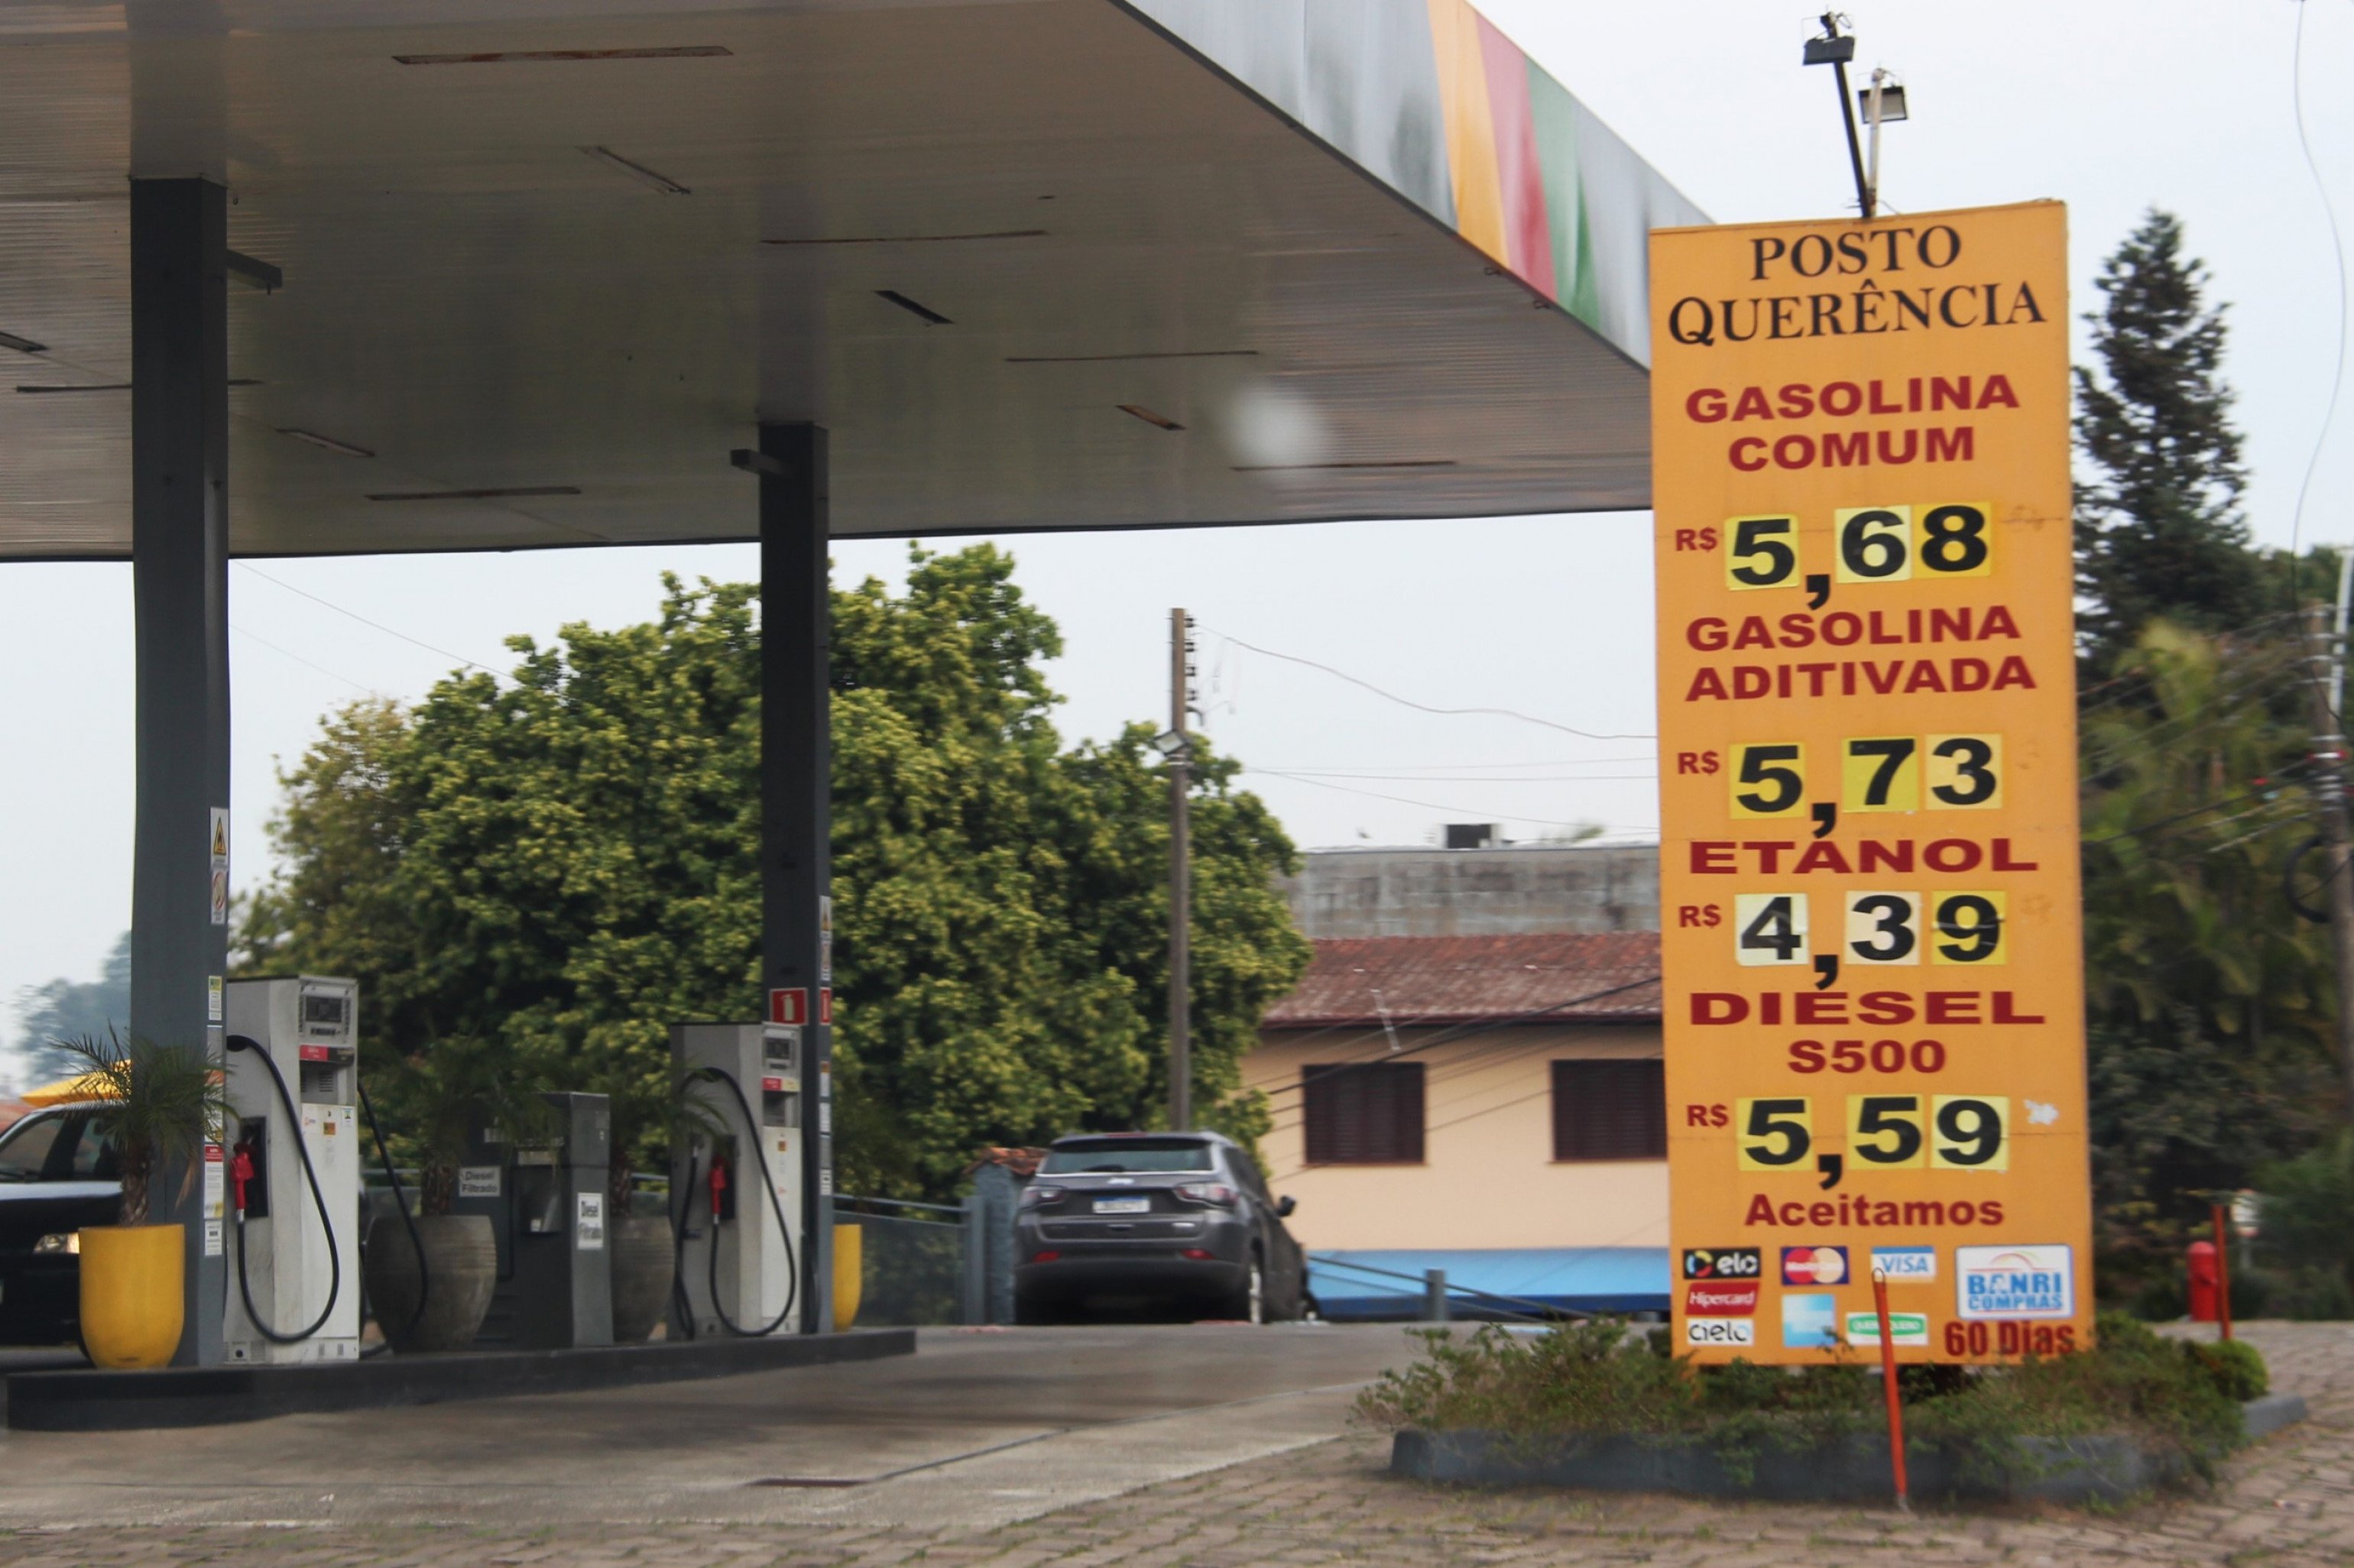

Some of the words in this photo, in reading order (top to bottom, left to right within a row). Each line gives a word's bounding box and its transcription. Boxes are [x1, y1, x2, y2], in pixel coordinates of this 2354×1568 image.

[1749, 225, 1962, 281] POSTO
[1668, 278, 2048, 347] QUERÊNCIA
[1685, 374, 2021, 424] GASOLINA
[1728, 426, 1974, 472] COMUM
[1675, 526, 1718, 554] R$
[1730, 504, 1988, 611] 5,68
[1685, 605, 2022, 652] GASOLINA
[1684, 655, 2038, 702] ADITIVADA
[1677, 750, 1720, 776] R$
[1735, 737, 1997, 839] 5,73
[1690, 838, 2038, 875] ETANOL
[1678, 904, 1721, 930] R$
[1740, 894, 2001, 991] 4,39
[1690, 992, 2046, 1025] DIESEL
[1788, 1039, 1947, 1074] S500
[1687, 1104, 1730, 1131] R$
[1743, 1097, 2002, 1191] 5,59
[1743, 1194, 2004, 1226] Aceitamos
[1717, 1252, 1758, 1275] elo
[1881, 1256, 1929, 1273] VISA
[1689, 1291, 1756, 1308] Hipercard
[1968, 1294, 2063, 1310] COMPRAS
[1944, 1321, 1989, 1356] 60
[1998, 1320, 2075, 1356] Dias
